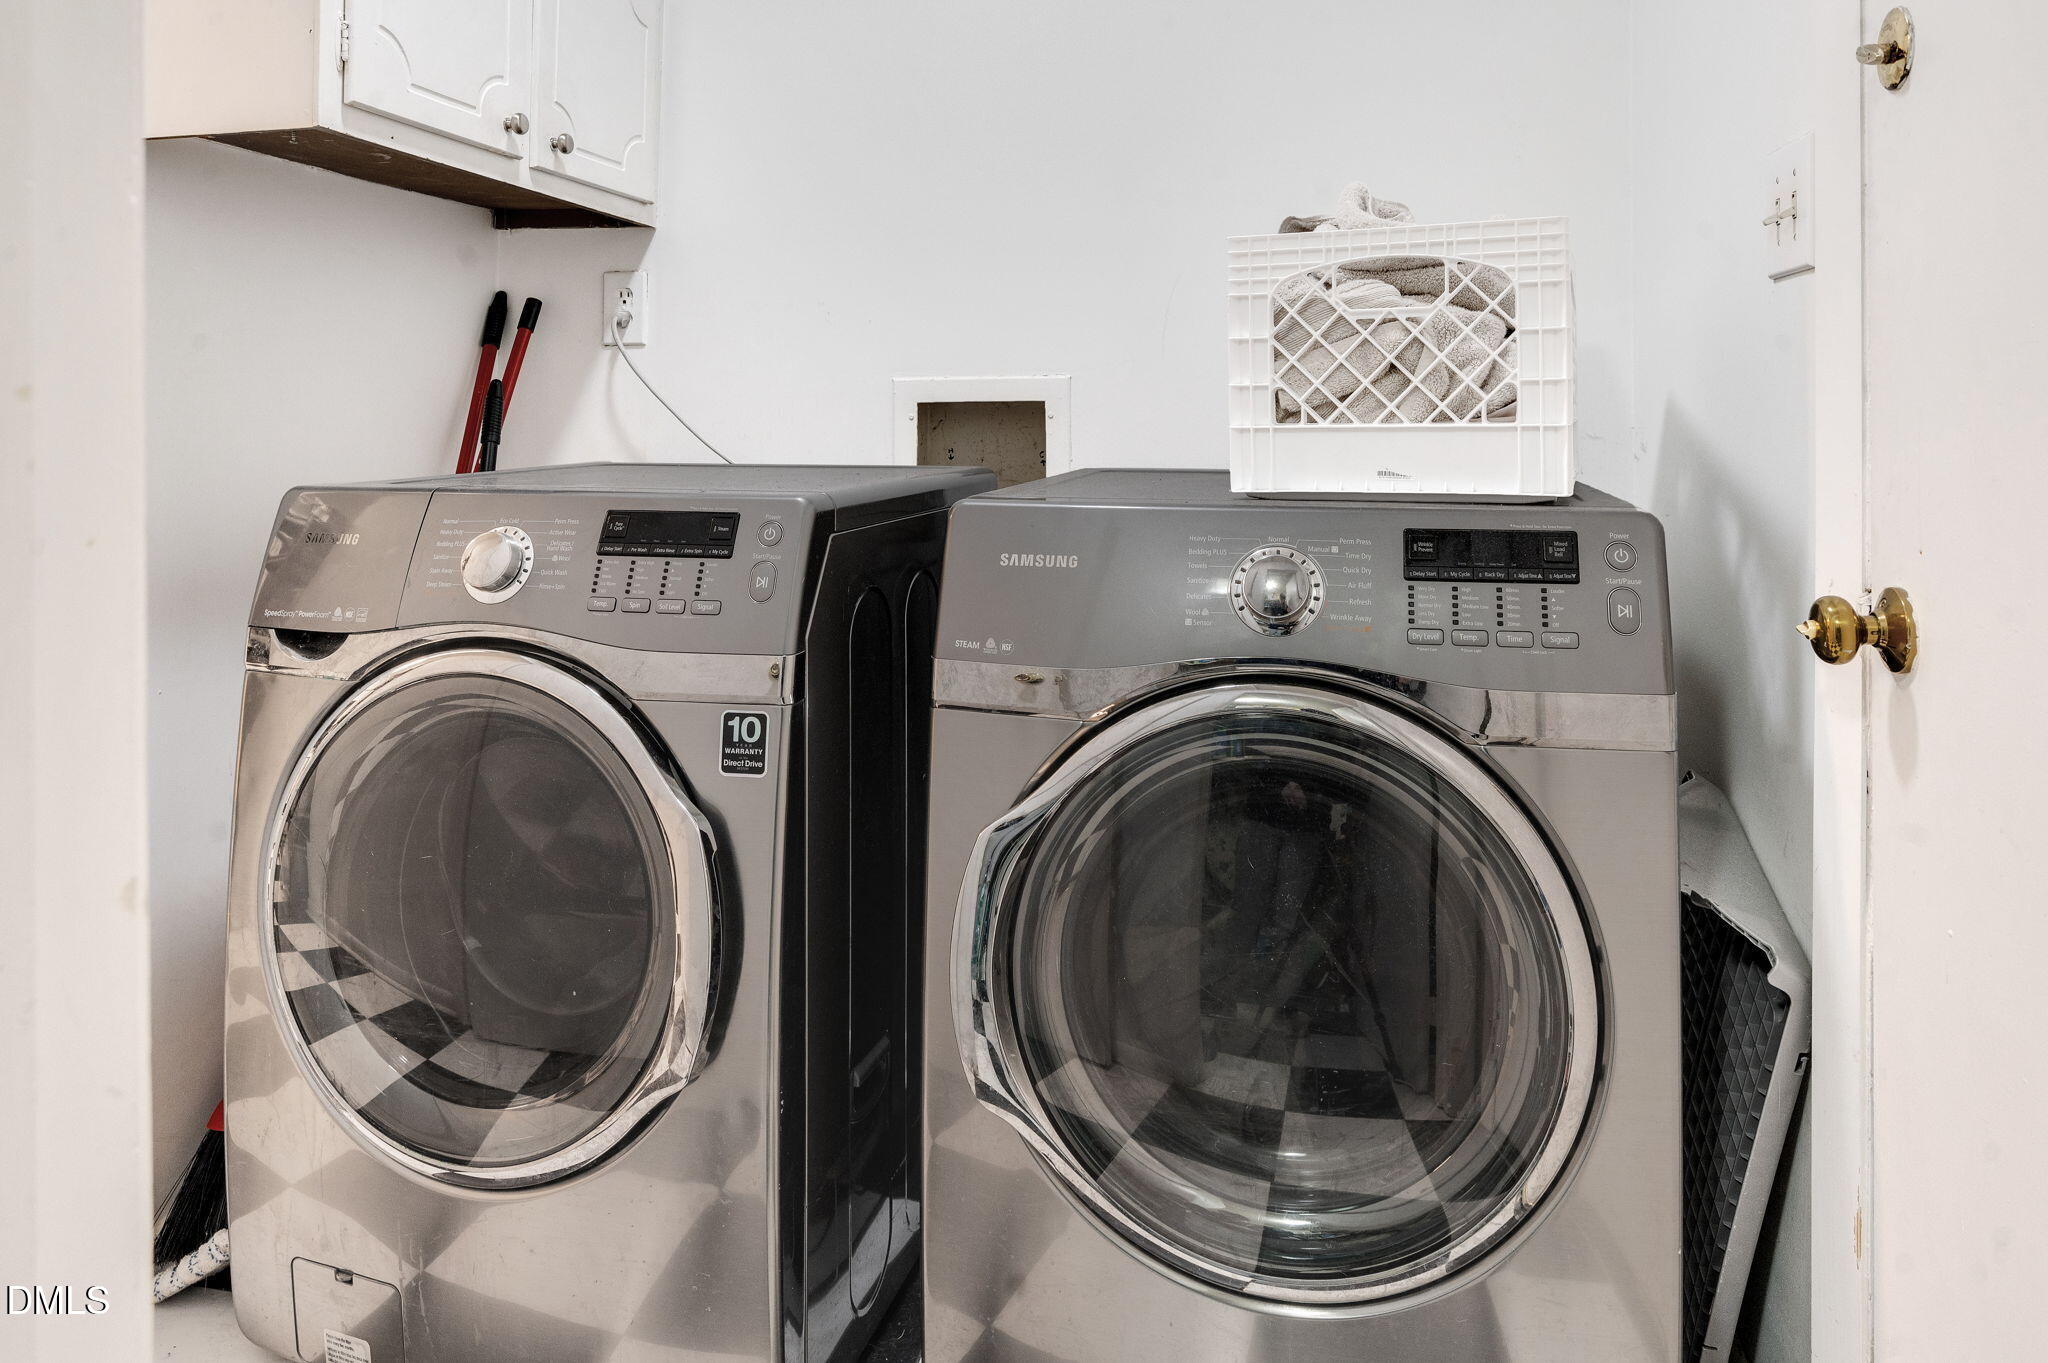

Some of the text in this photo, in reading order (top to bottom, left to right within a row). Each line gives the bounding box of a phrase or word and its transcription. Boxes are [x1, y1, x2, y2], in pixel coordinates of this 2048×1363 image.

[304, 532, 360, 545] SAMSUNG
[1208, 535, 1220, 543] Duty
[1188, 548, 1227, 556] Bedding PLUS
[1307, 545, 1330, 553] Manual
[1000, 552, 1079, 568] SAMSUNG
[1361, 552, 1372, 561] Dry
[1188, 561, 1208, 569] Towels
[1342, 566, 1372, 575] Quick Dry
[1605, 577, 1642, 585] Start/Pause
[629, 601, 640, 609] Spin
[1330, 613, 1372, 623] Wrinkle Away
[1412, 632, 1440, 640] Dry Level
[1459, 633, 1480, 642] Temp.
[1506, 635, 1523, 643] Time
[955, 639, 980, 649] STEAM
[1550, 636, 1571, 645] Signal
[1002, 643, 1013, 651] NSF
[727, 716, 762, 743] 10
[724, 747, 763, 755] WARRANTY
[723, 759, 763, 768] Direct Drive
